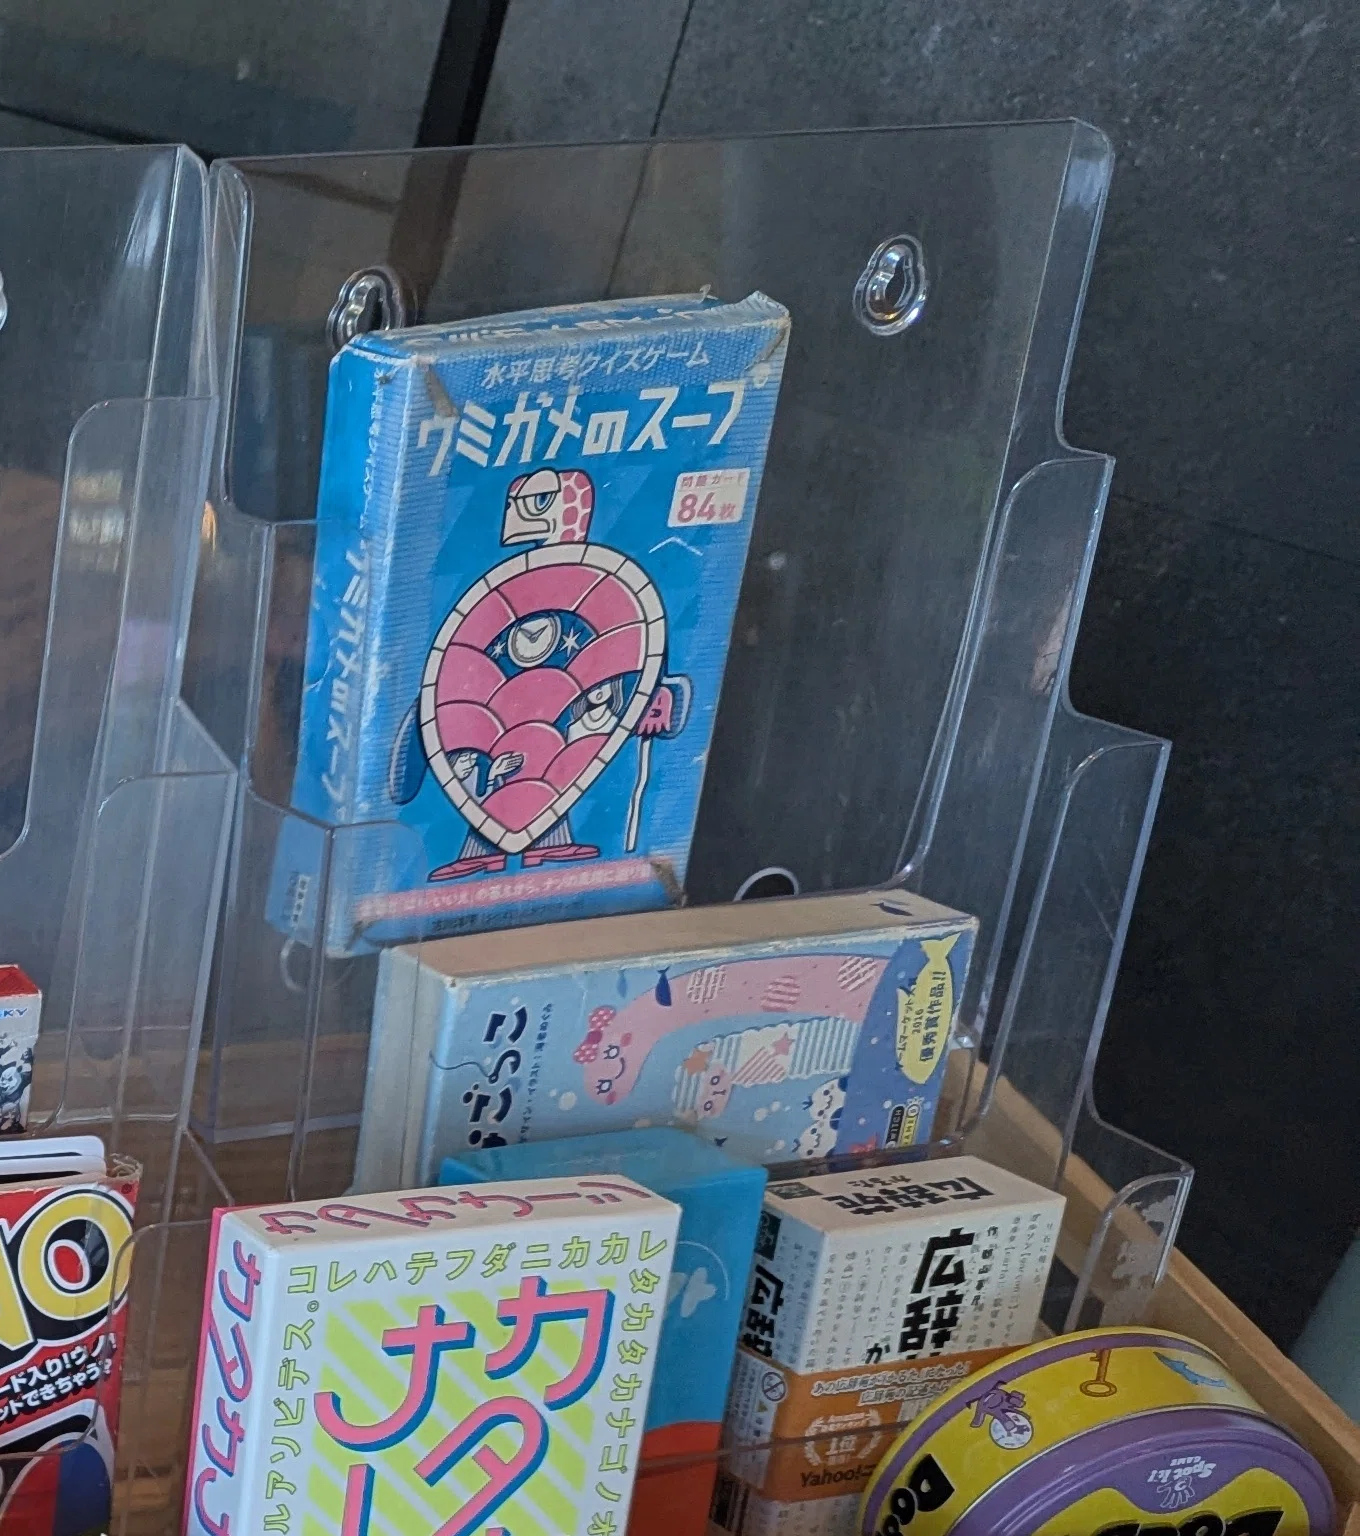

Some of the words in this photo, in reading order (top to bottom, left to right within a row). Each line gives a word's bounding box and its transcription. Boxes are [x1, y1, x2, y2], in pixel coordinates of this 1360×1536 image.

[482, 342, 710, 389] 水平思考クイズゲーム
[258, 1180, 653, 1237] カタカナーシ
[820, 1176, 996, 1216] 広辞苑
[896, 1226, 976, 1360] 広辞
[1181, 1462, 1217, 1482] Spot
